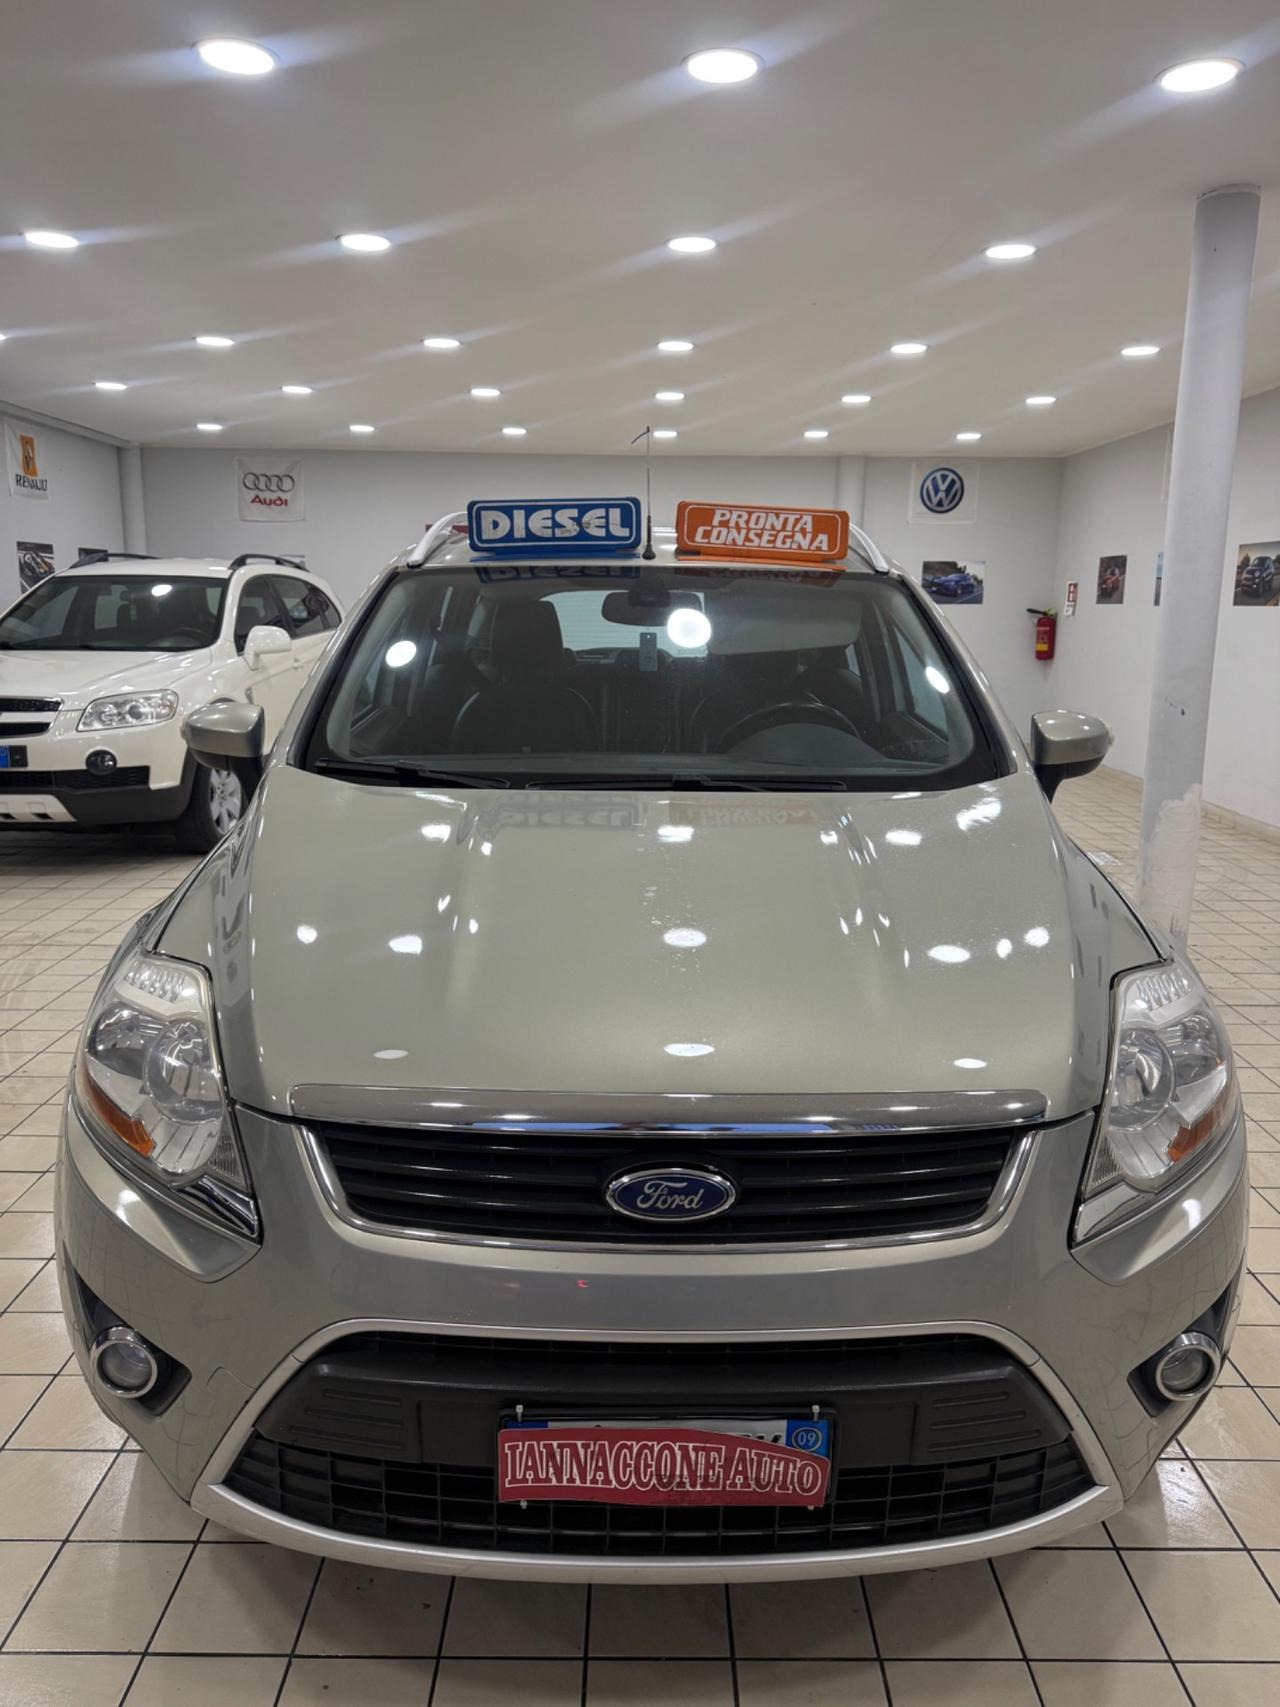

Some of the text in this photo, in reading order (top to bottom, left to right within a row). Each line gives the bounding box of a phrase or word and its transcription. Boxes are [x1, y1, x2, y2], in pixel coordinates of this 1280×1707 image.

[250, 494, 288, 507] Audi
[480, 508, 630, 540] DIESEL
[712, 508, 813, 532] PRONTA
[694, 526, 829, 551] CONSEGNA
[636, 1180, 704, 1209] Ford
[797, 1432, 816, 1447] 09
[505, 1441, 822, 1495] IANNACCONE AUTO
